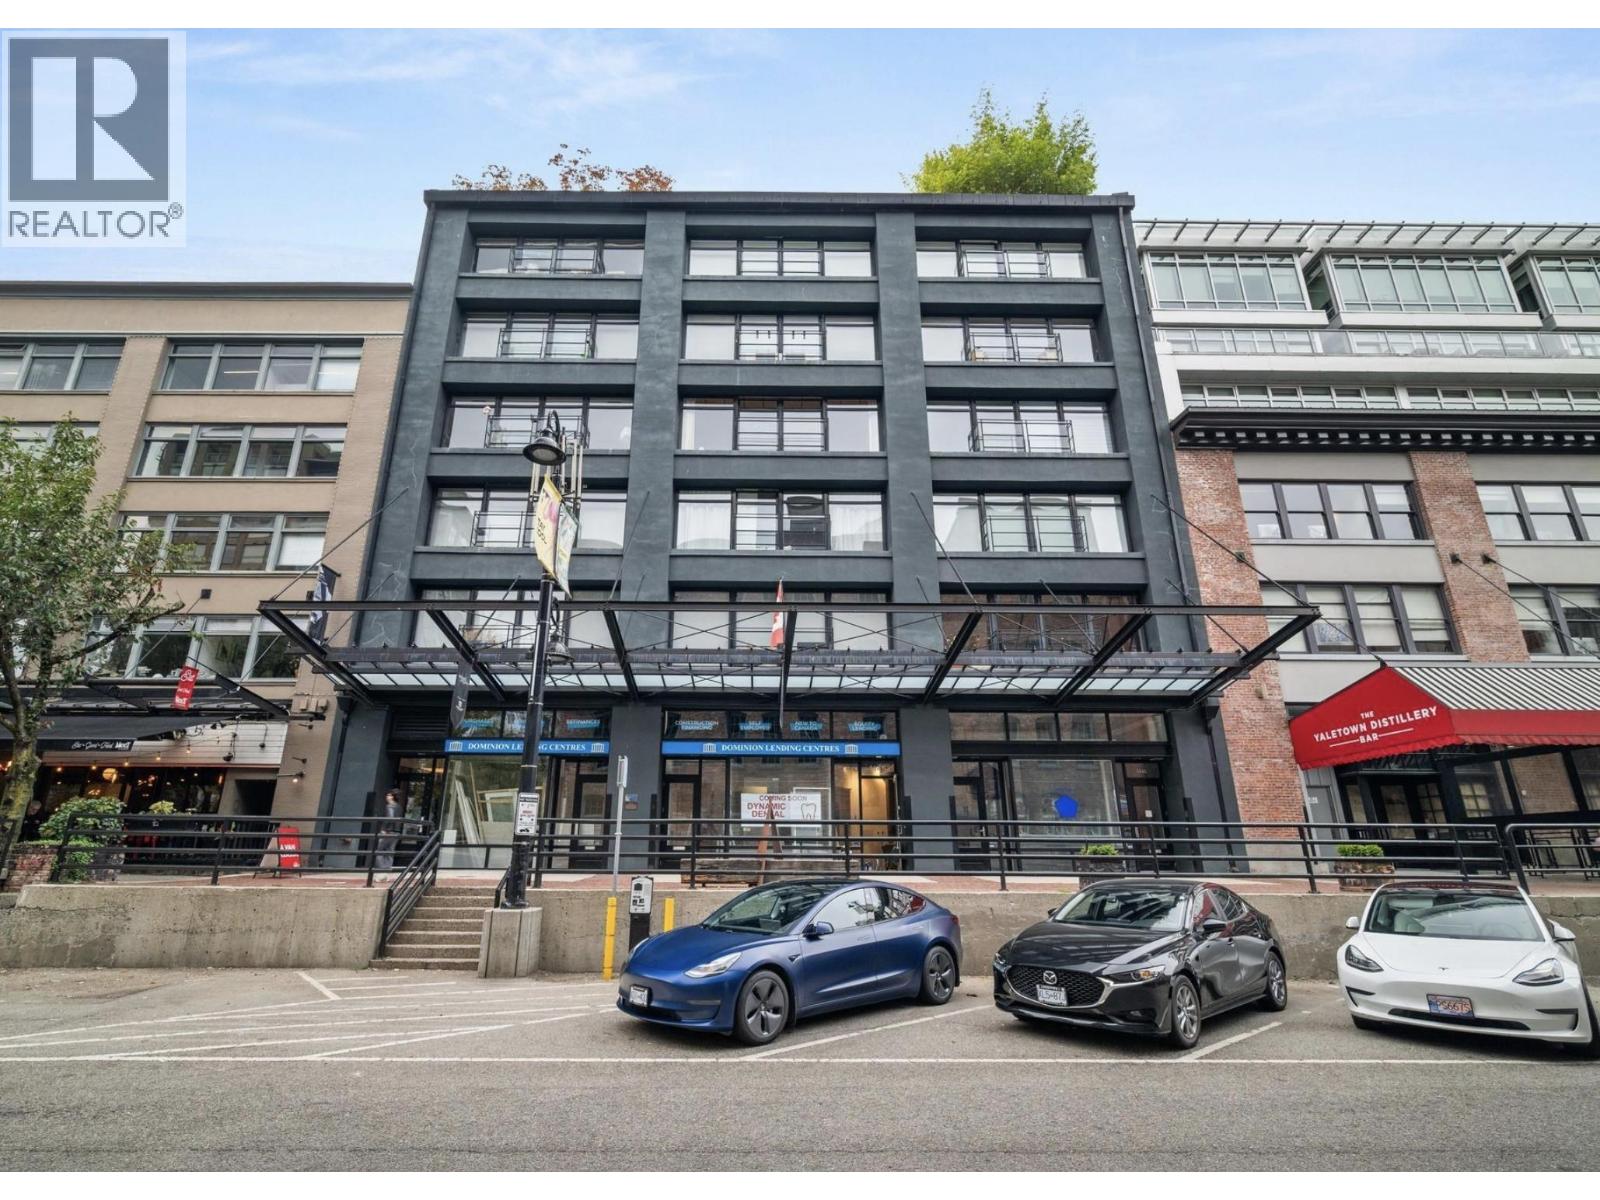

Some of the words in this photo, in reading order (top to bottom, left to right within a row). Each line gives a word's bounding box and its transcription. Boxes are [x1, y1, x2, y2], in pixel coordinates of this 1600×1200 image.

[1360, 710, 1375, 719] THE
[1313, 723, 1367, 743] YALETOWN
[1370, 706, 1438, 729] DISTILLERY
[1360, 733, 1379, 744] BAR
[468, 742, 510, 750] DOMINION
[549, 743, 586, 751] CENTRES
[721, 743, 763, 751] DOMINION
[765, 744, 802, 752] LENDING
[803, 744, 840, 753] CENTRES
[751, 810, 785, 818] DENAL
